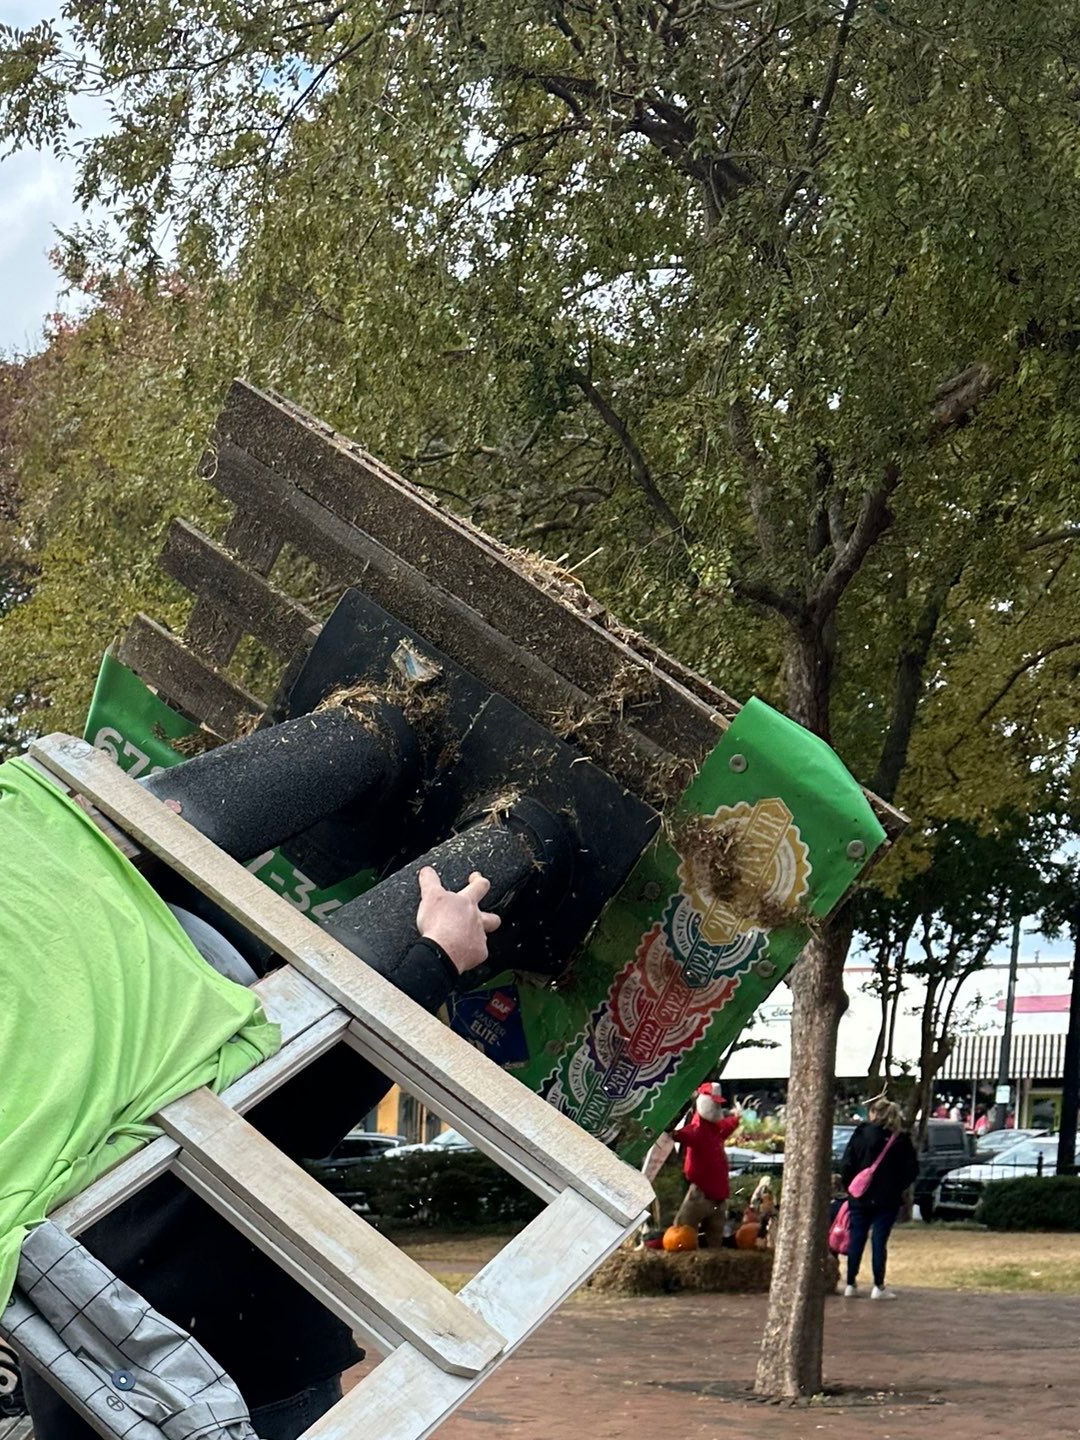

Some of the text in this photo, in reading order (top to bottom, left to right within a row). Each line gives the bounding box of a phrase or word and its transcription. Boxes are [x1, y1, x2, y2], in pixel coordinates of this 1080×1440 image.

[94, 727, 165, 779] 67
[676, 909, 690, 952] BEST OF
[685, 946, 718, 984] 2024
[491, 998, 511, 1014] GAF
[470, 1019, 499, 1045] ELITE
[634, 1022, 662, 1060] 2022
[606, 1060, 635, 1095] 2021
[581, 1093, 609, 1130] 2020
